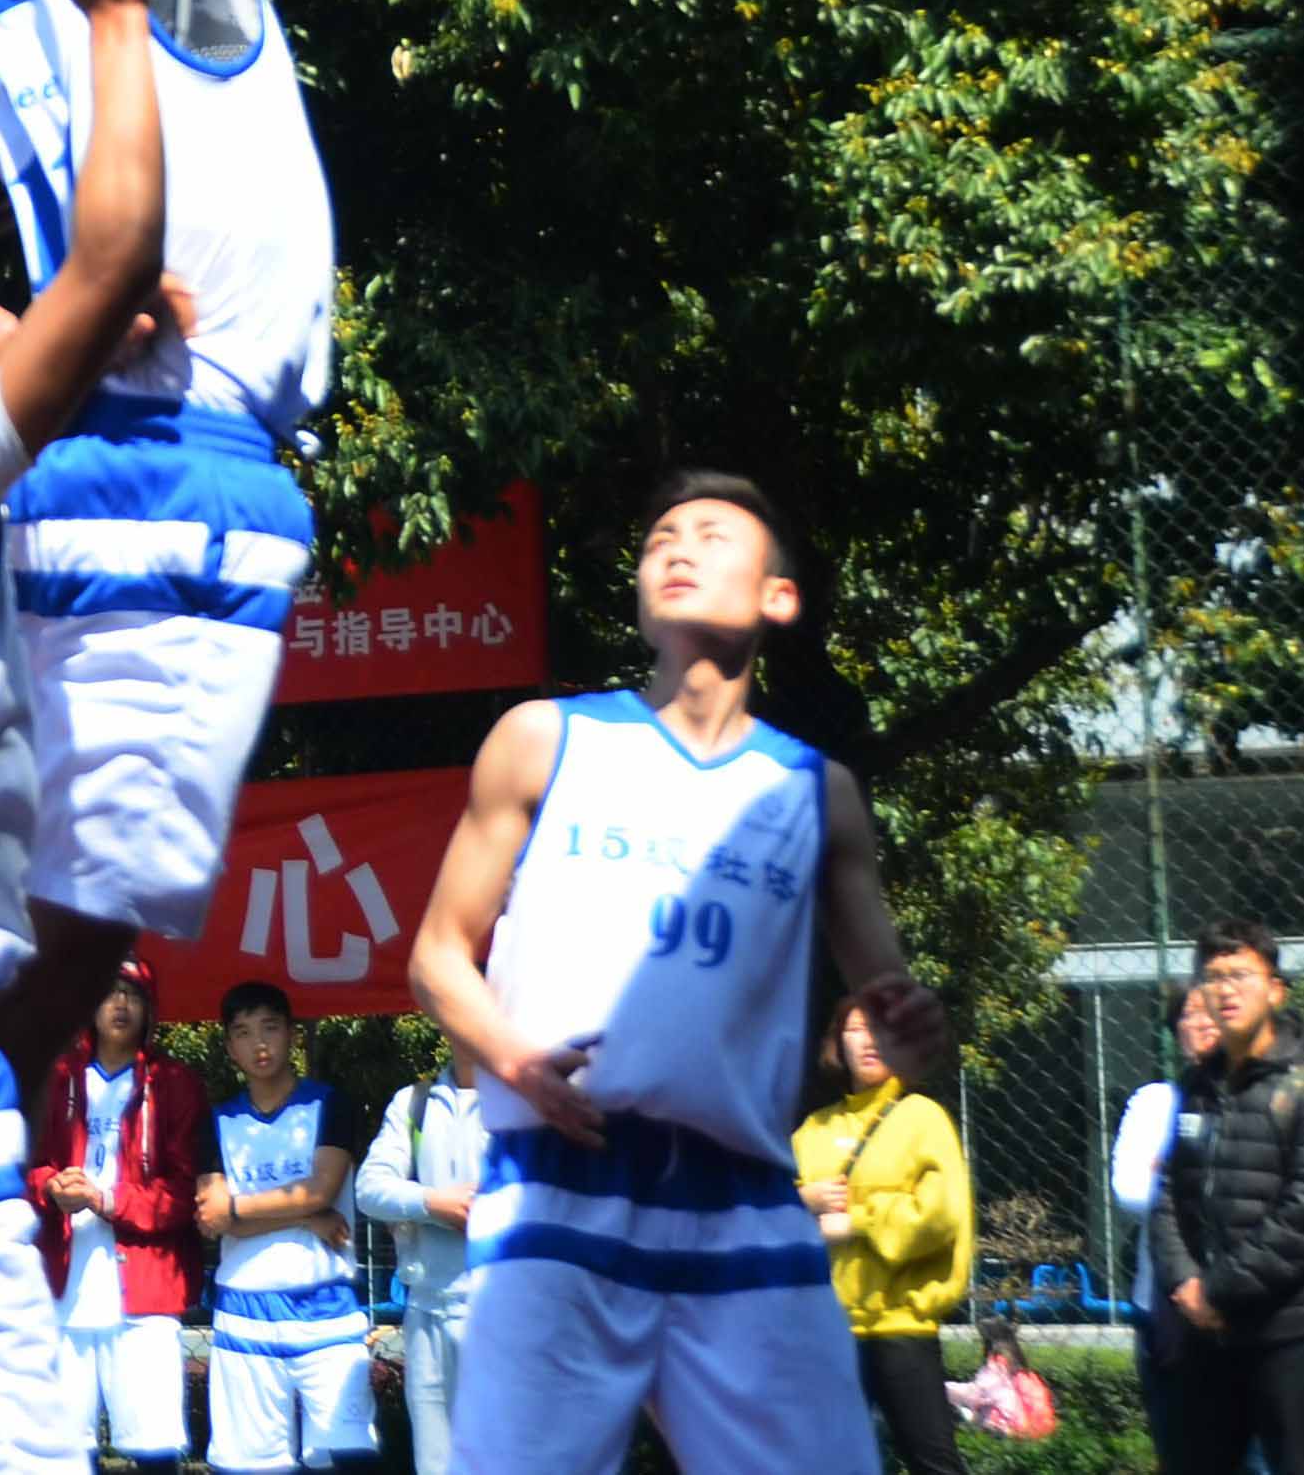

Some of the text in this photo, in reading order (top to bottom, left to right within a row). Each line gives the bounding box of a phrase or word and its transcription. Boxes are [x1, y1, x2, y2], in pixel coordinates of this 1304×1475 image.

[288, 602, 513, 658] 与指导中心
[239, 813, 400, 983] 心
[648, 893, 733, 969] 99
